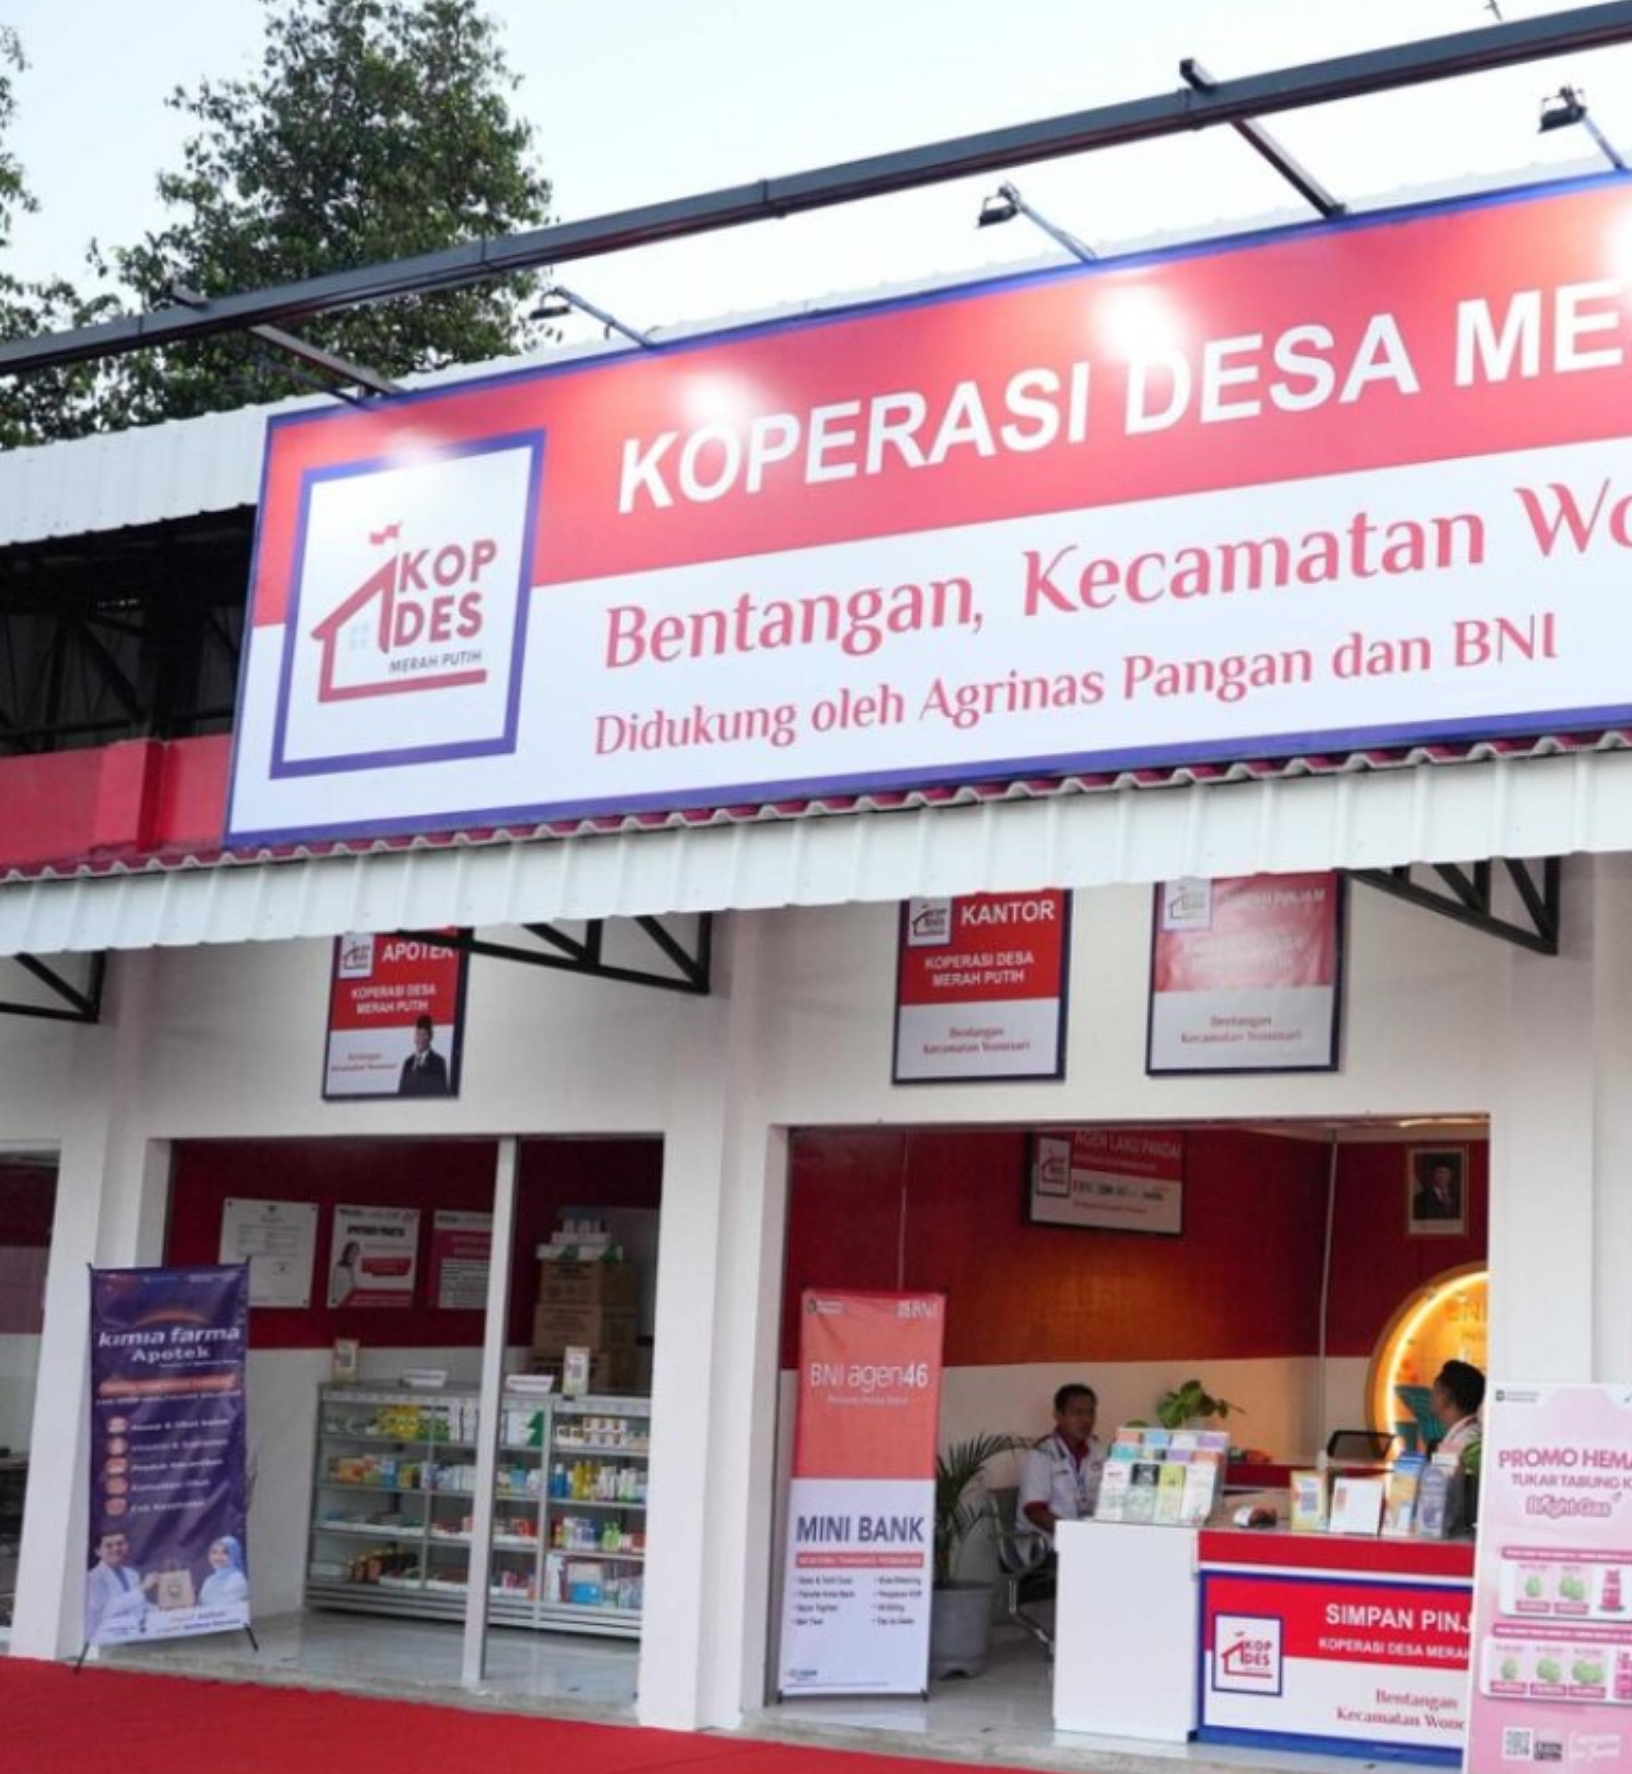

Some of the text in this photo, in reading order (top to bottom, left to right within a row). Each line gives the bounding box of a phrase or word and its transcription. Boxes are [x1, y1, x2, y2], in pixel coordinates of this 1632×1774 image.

[617, 361, 1088, 513] KOPERASI
[1124, 314, 1420, 436] DESA
[399, 540, 496, 593] KOP
[604, 572, 983, 669] Bentangan,
[1022, 509, 1486, 616] Kecamatan
[394, 592, 482, 647] DES
[389, 651, 482, 673] MERAH PUTIH
[595, 612, 1558, 756] Didukung oleh Agrinas Pangan dan BNI
[961, 900, 1055, 926] KANTOR
[924, 950, 1034, 970] KOPERASI DESA
[932, 970, 1024, 987] MERAH PUTIH
[99, 1327, 240, 1347] kimia farma
[132, 1345, 210, 1363] Apotek
[811, 1363, 928, 1393] BNI agen46
[1498, 1448, 1578, 1468] PROMO
[1511, 1473, 1557, 1488] TUKAR
[1561, 1474, 1620, 1490] TABUNG
[796, 1516, 925, 1542] MINI BANK
[1326, 1603, 1414, 1631] SIMPAN
[1318, 1638, 1384, 1655] KOPERASI
[1387, 1643, 1422, 1657] DESA
[1375, 1689, 1458, 1711] Bentangan
[1336, 1707, 1419, 1728] Kecamatan
